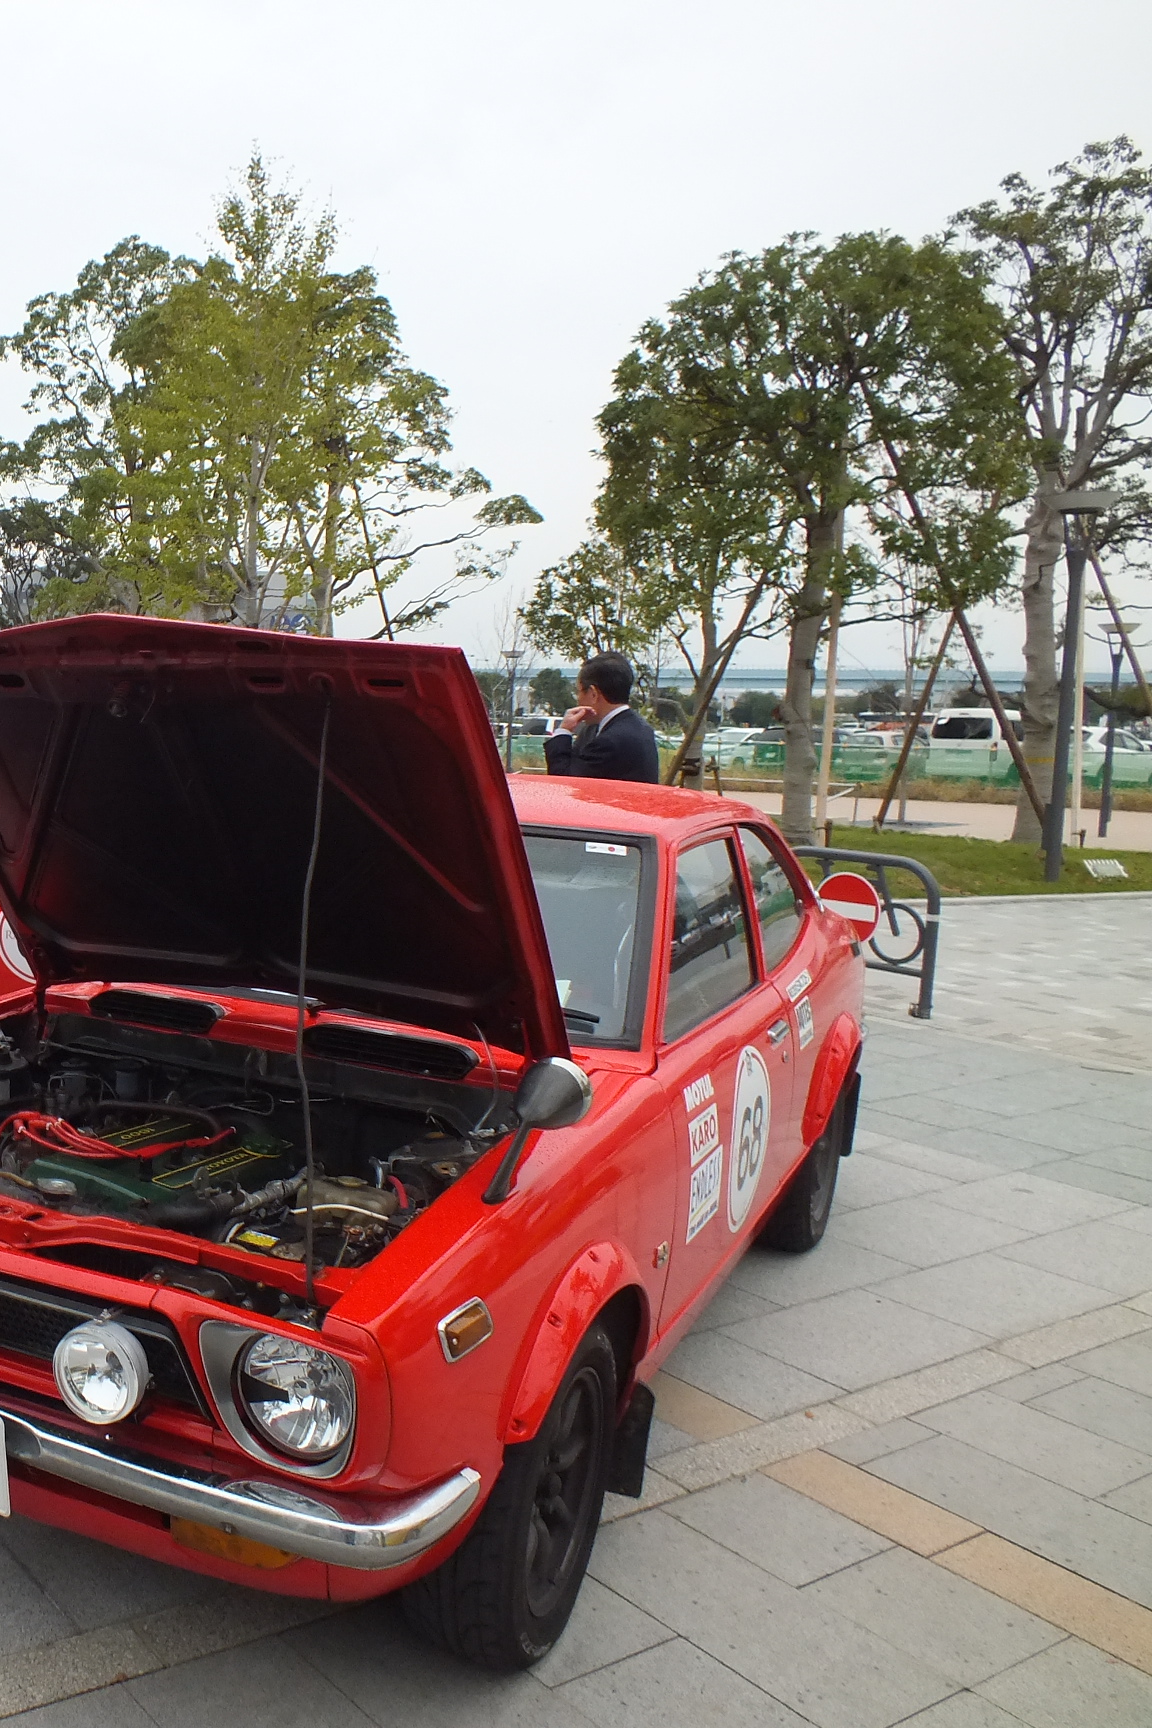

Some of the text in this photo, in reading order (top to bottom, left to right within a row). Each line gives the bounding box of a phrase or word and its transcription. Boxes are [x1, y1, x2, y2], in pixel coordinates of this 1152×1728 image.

[684, 1074, 714, 1112] MOTUL
[691, 1114, 716, 1155] KARO
[738, 1095, 763, 1191] 68
